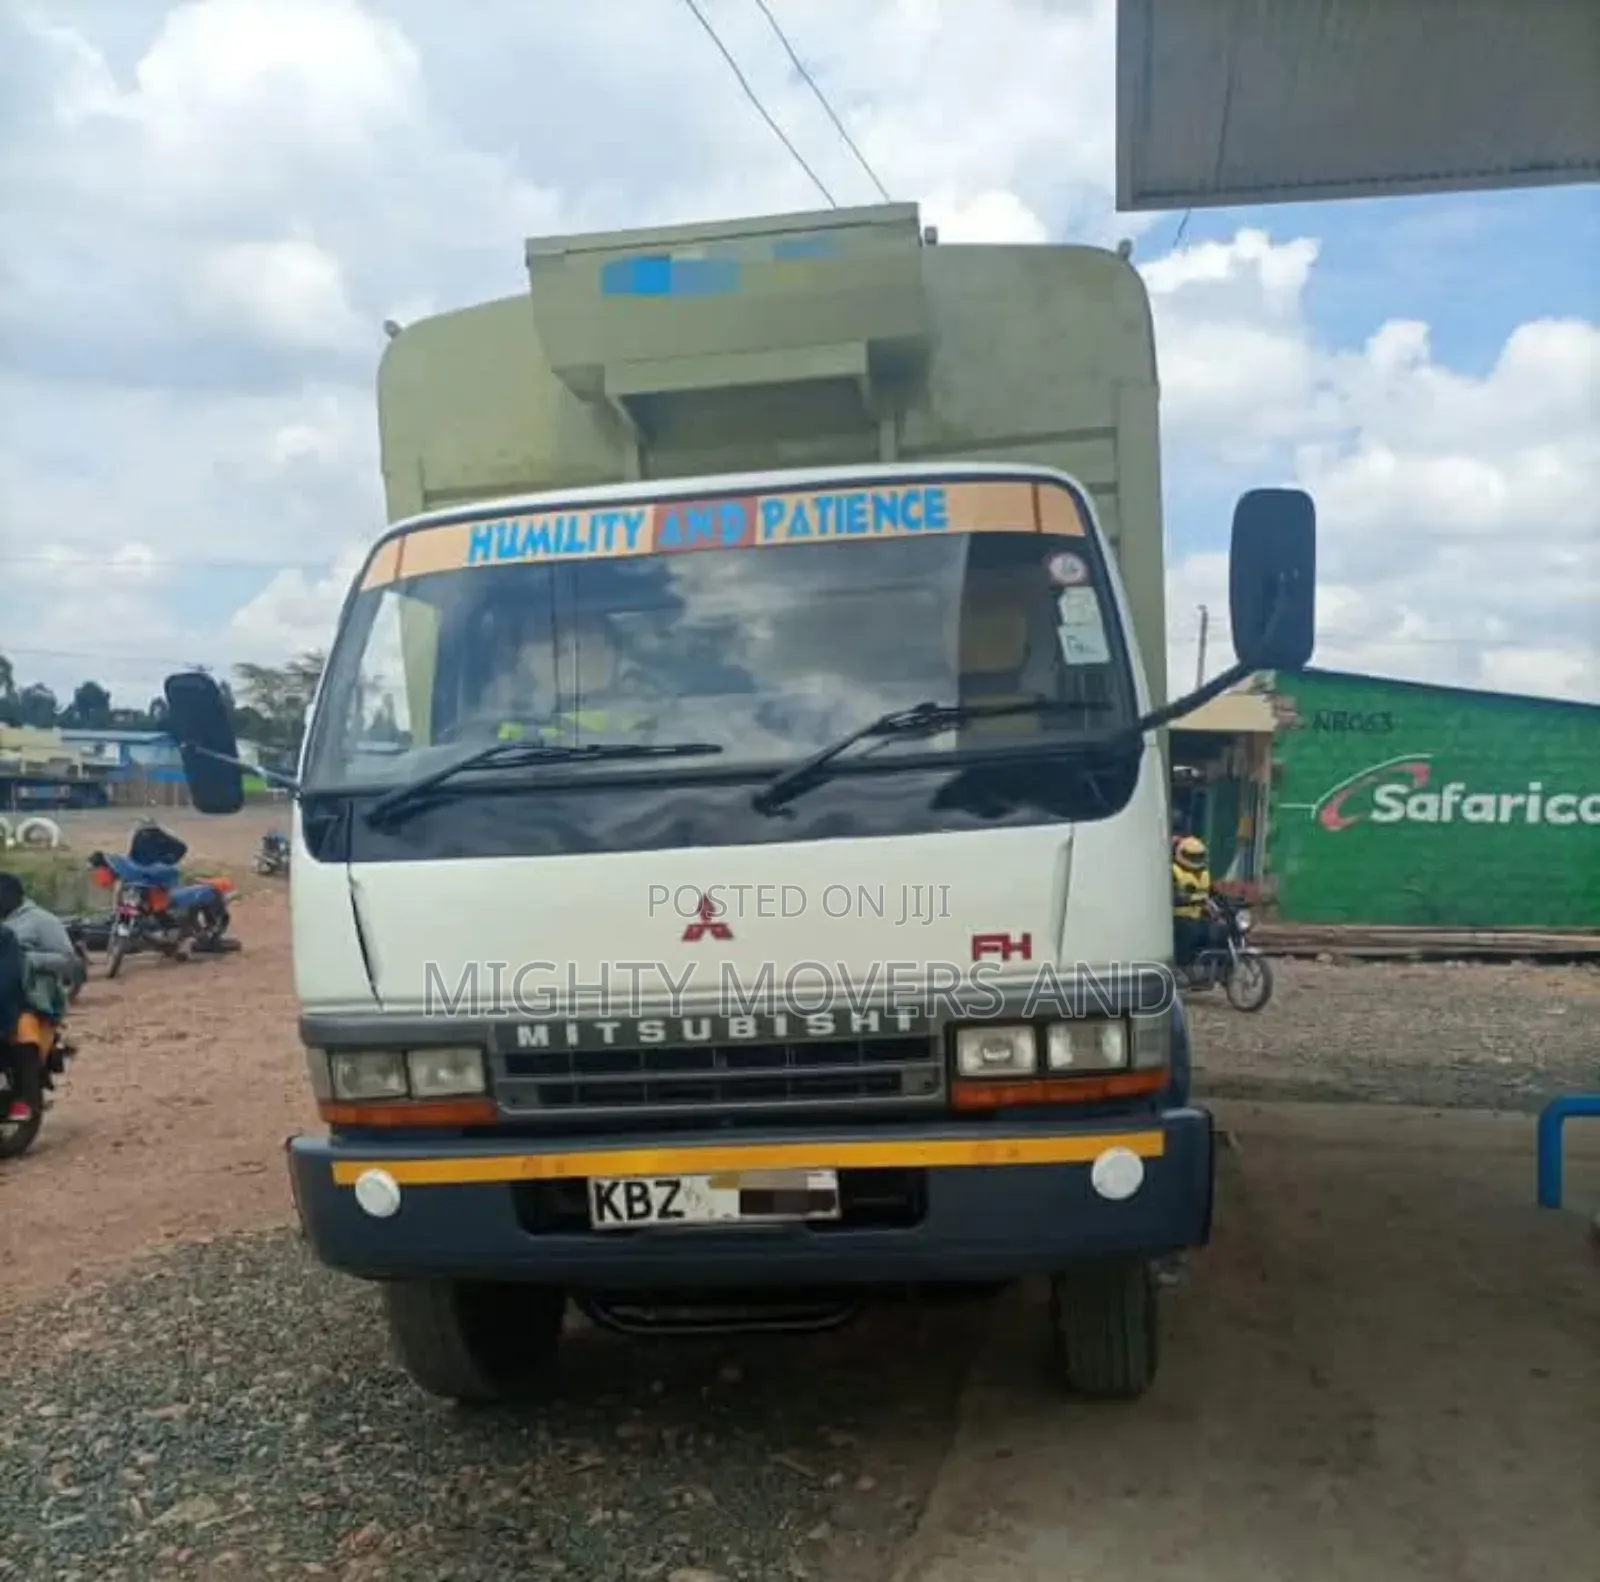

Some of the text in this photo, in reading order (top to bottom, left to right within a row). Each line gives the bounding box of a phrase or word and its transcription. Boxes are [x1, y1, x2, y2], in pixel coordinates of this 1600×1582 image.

[467, 487, 948, 563] HUMILITY AND PATIENCE
[971, 932, 1032, 962] FH
[517, 1010, 916, 1048] MITSUBISHI
[594, 1179, 686, 1222] KBZ
